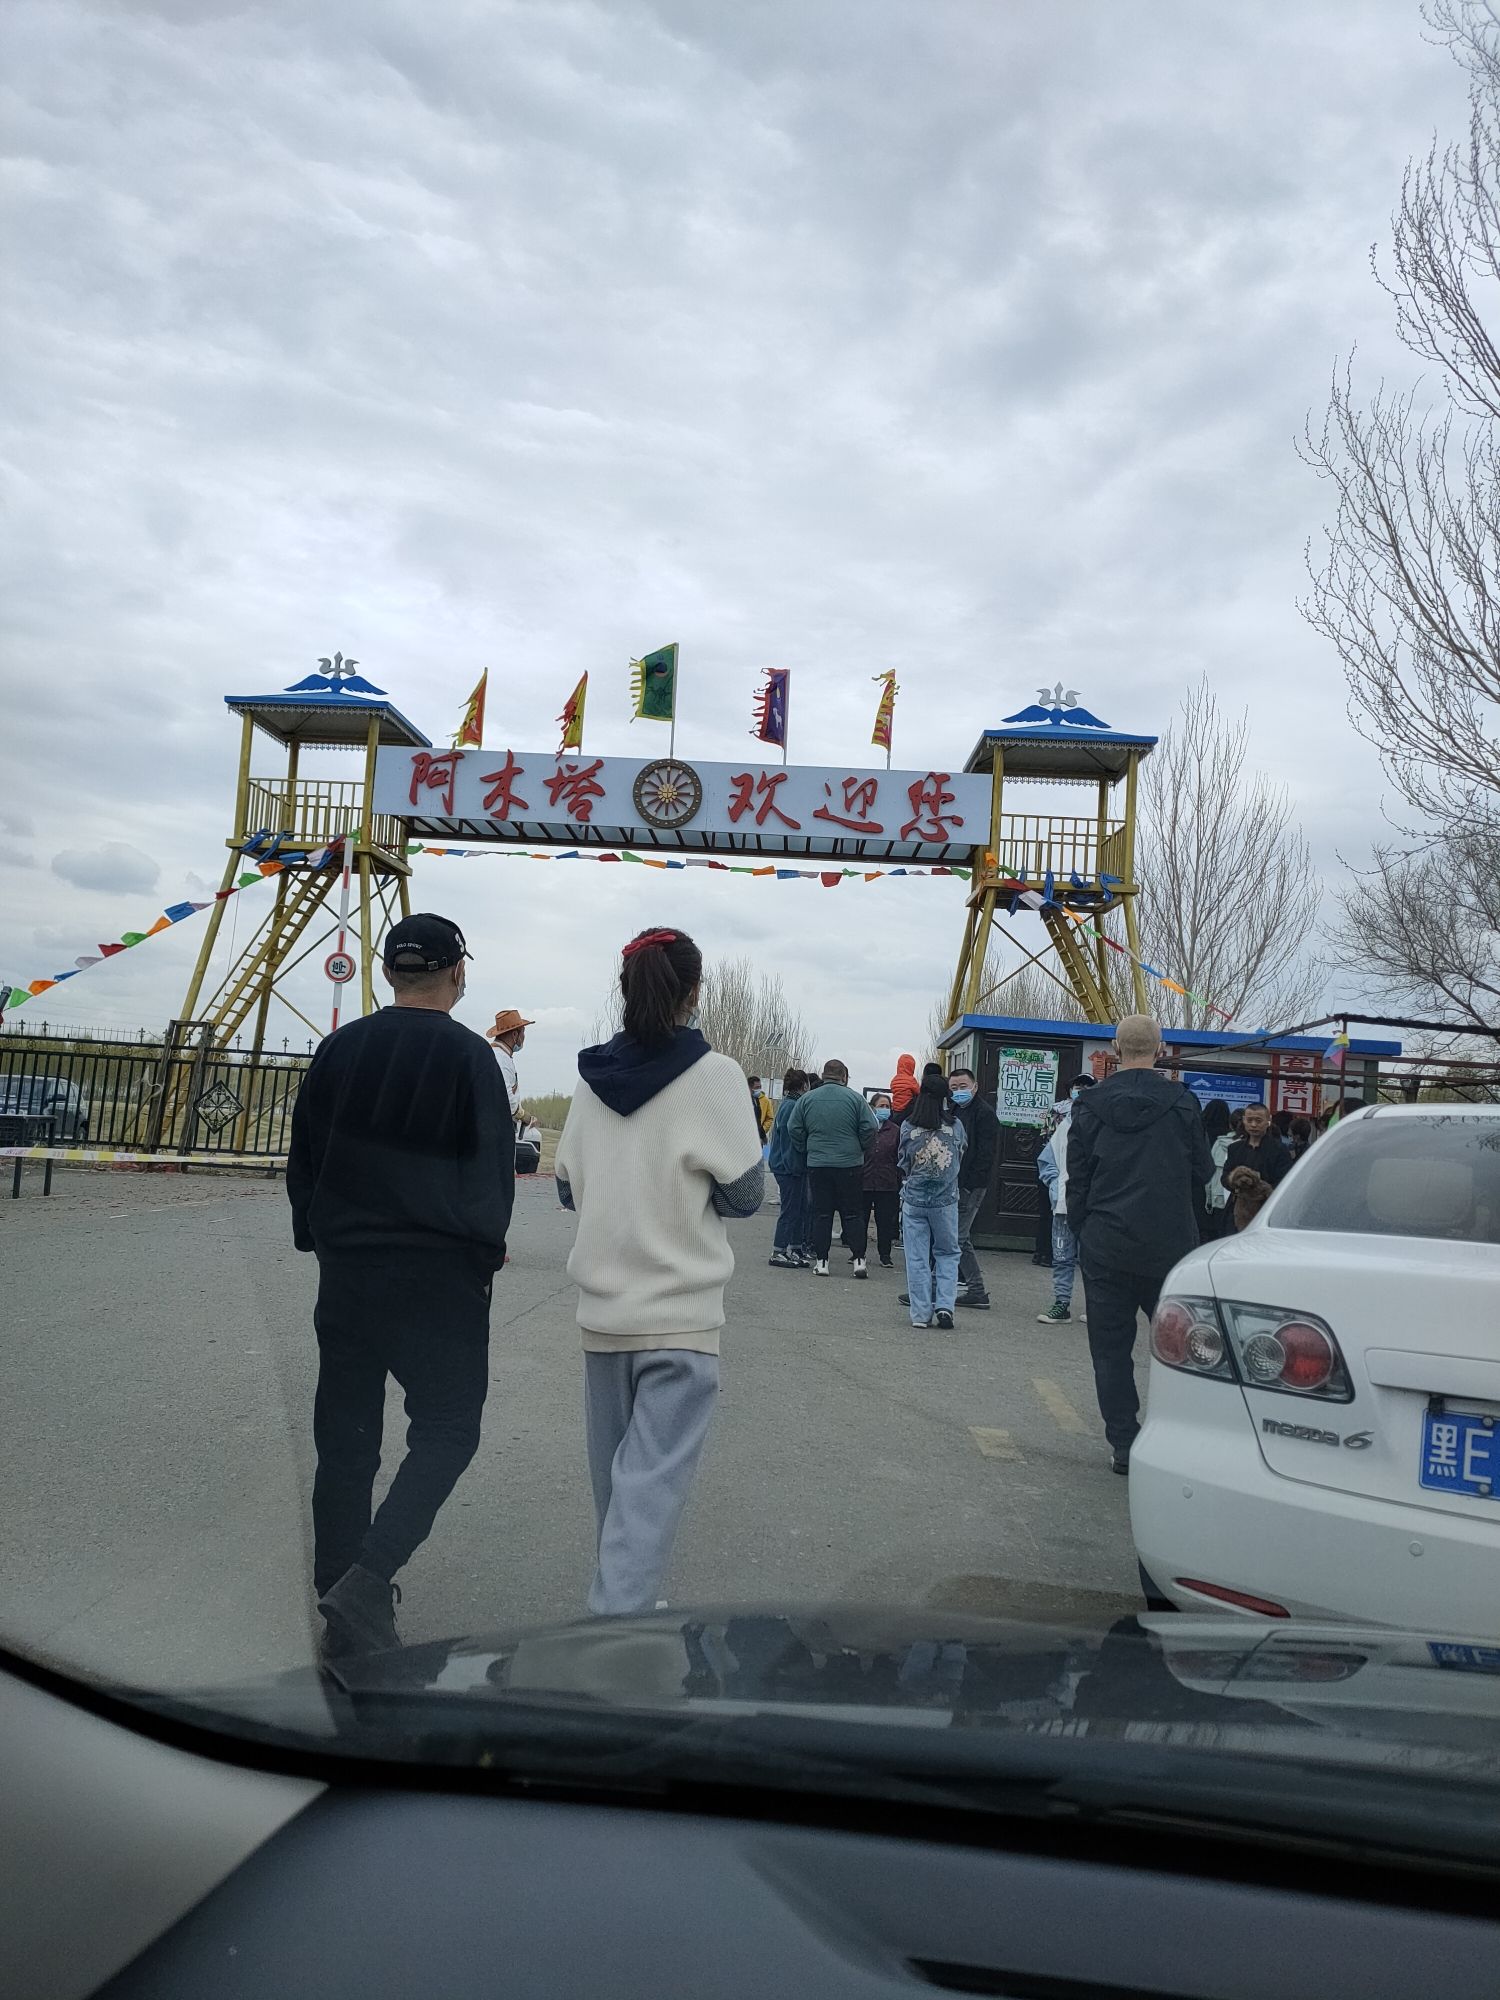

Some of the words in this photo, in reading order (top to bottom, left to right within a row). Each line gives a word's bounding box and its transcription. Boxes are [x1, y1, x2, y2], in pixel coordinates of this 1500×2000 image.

[409, 748, 606, 823] 阿木塔
[728, 771, 964, 843] 欢迎您
[331, 961, 347, 975] 停
[1001, 1064, 1055, 1093] 微信
[1004, 1091, 1050, 1109] 领票处
[1262, 1418, 1340, 1447] mazda
[1343, 1430, 1375, 1450] 6
[1428, 1422, 1494, 1484] 黑E
